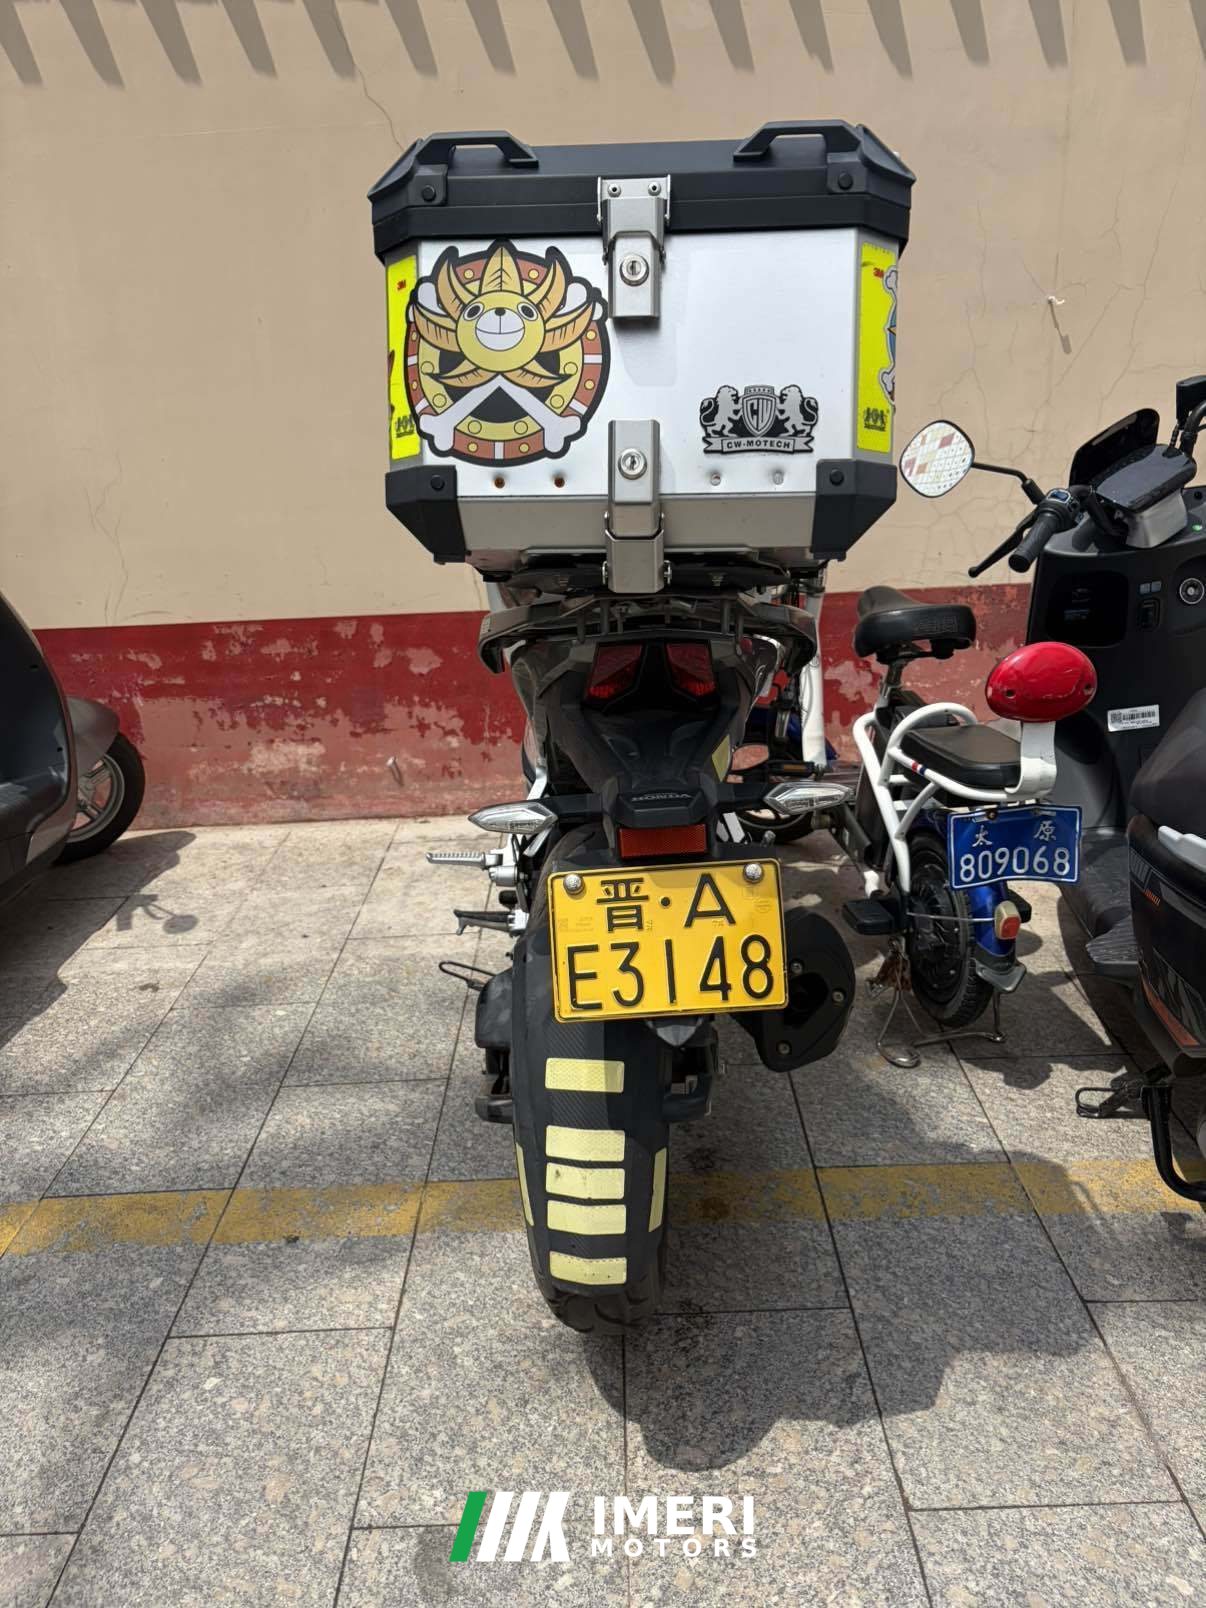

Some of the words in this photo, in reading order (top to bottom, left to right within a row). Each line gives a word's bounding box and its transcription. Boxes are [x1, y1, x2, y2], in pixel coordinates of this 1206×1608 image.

[972, 820, 1057, 847] 太原
[959, 846, 1071, 883] 809068
[567, 933, 774, 1011] E3148
